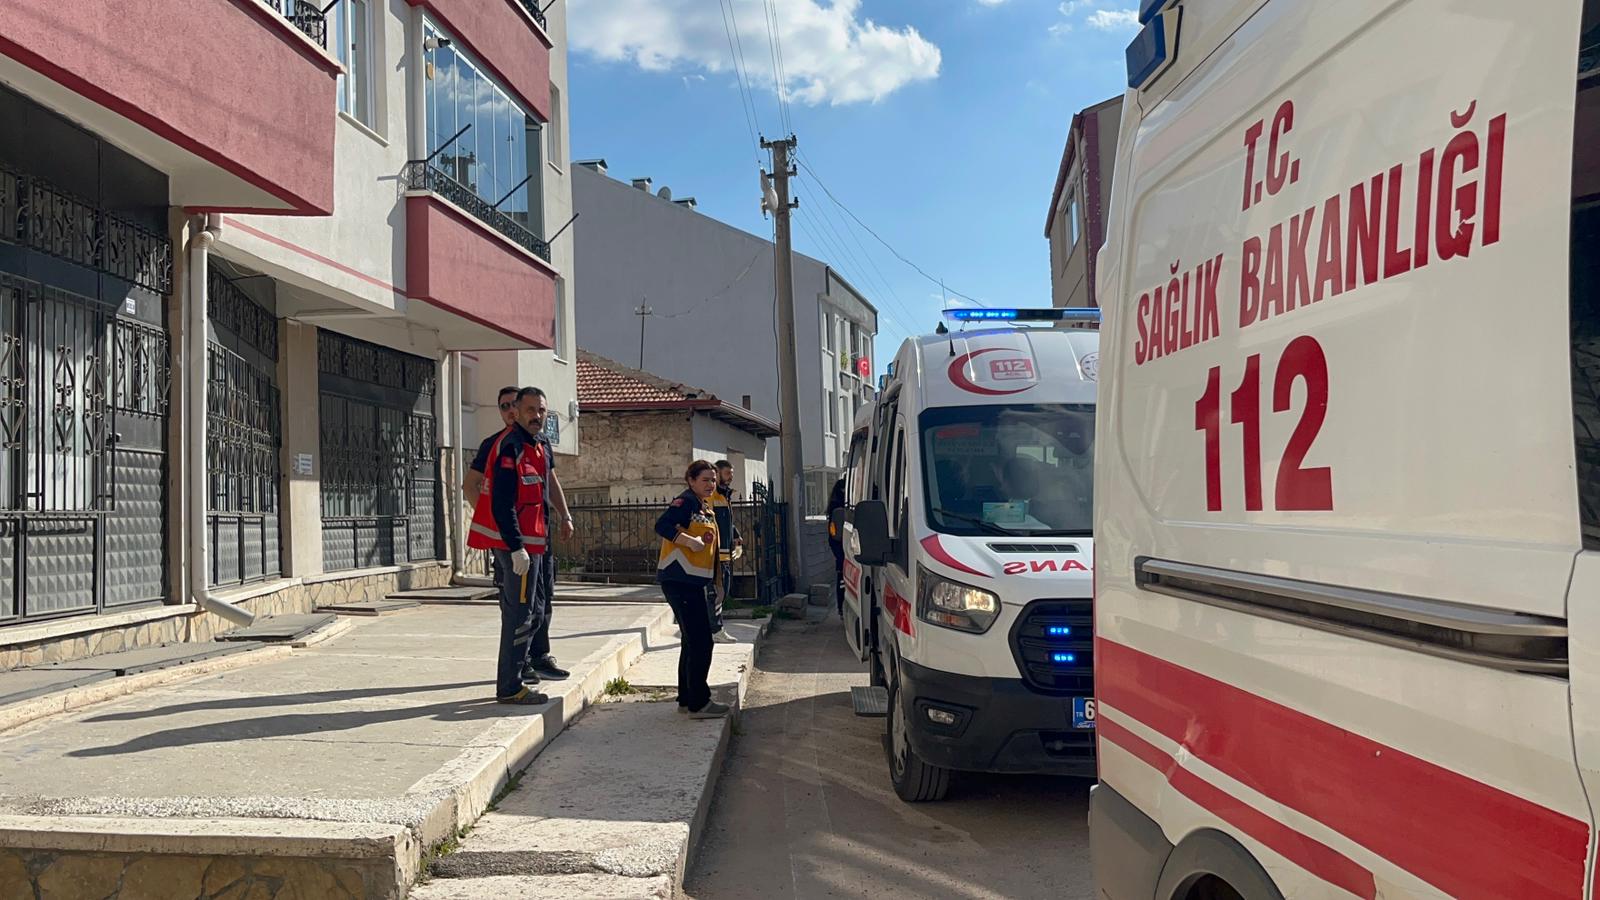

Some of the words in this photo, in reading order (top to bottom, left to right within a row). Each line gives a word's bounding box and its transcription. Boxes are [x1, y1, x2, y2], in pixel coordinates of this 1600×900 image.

[1241, 100, 1301, 212] T.C.
[1134, 252, 1224, 366] SAĞLIK
[1238, 99, 1507, 329] BAKANLIĞI
[995, 360, 1026, 372] 112
[1194, 335, 1334, 512] 112
